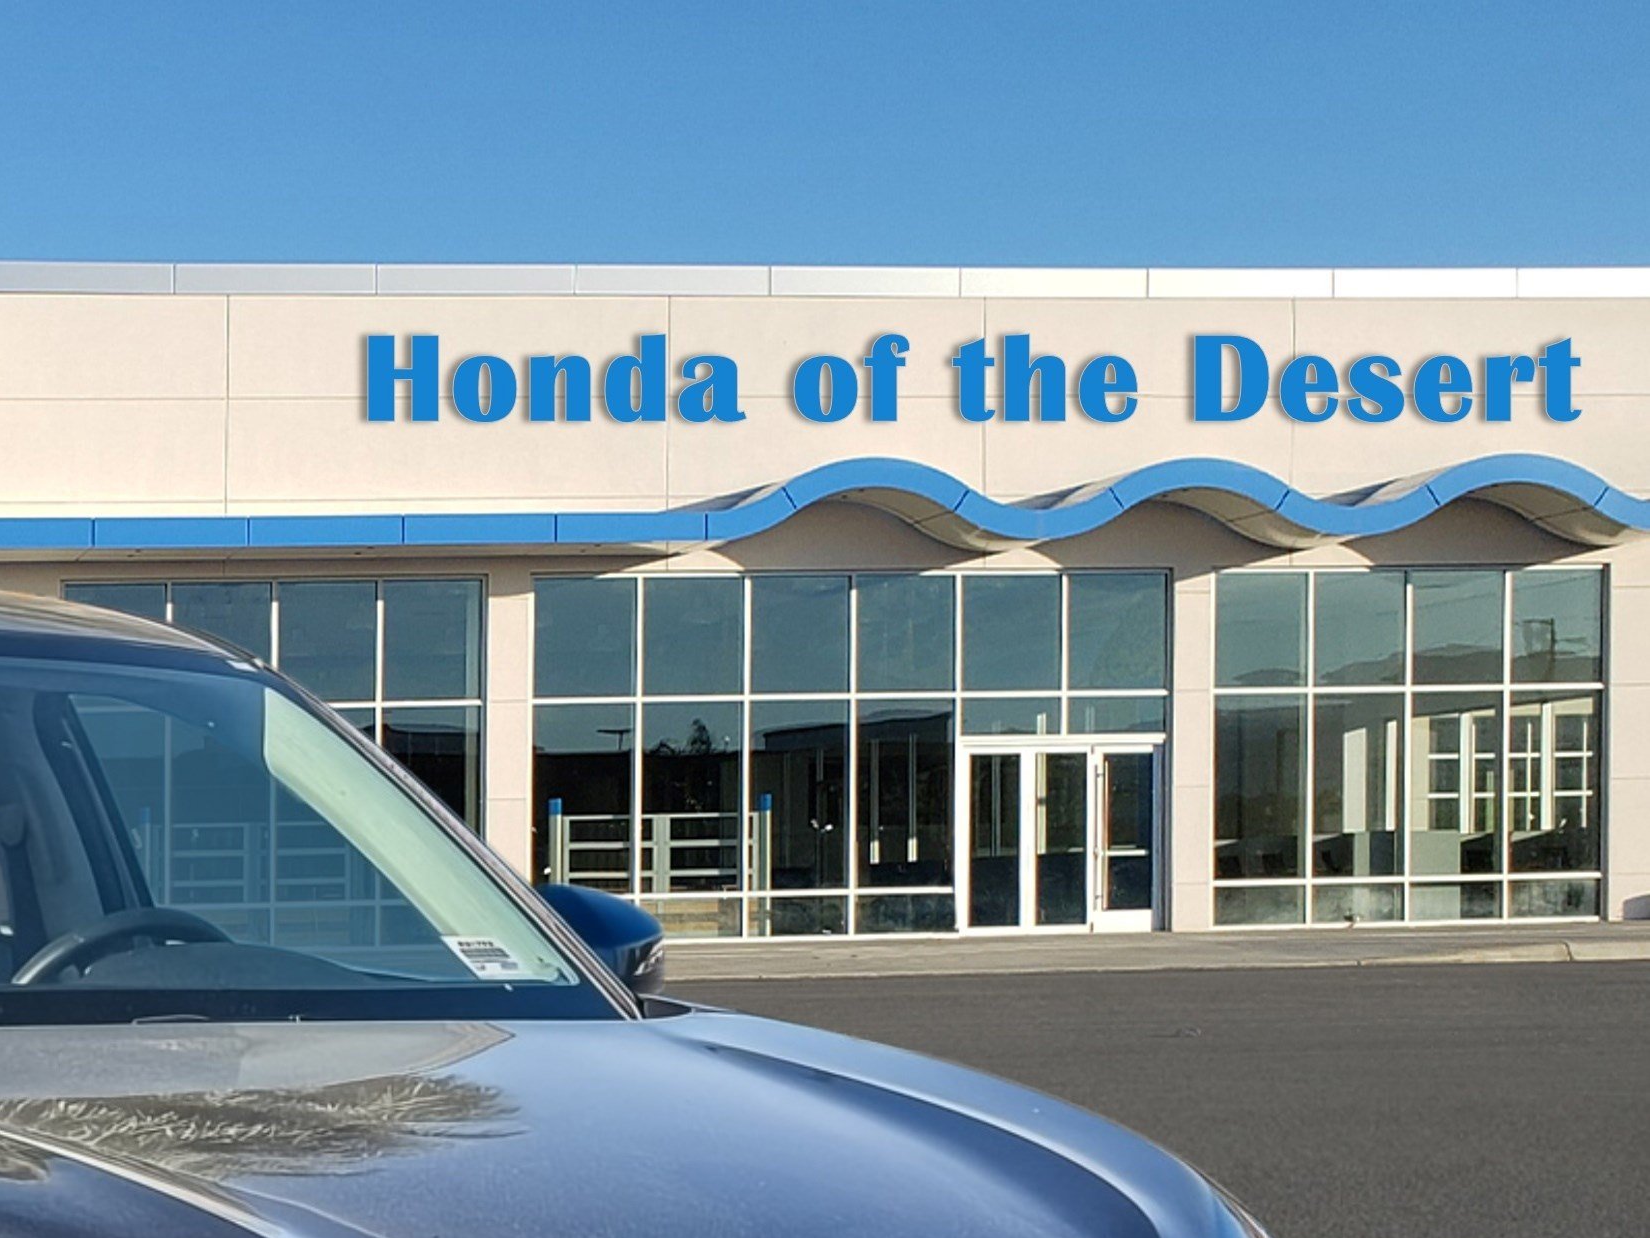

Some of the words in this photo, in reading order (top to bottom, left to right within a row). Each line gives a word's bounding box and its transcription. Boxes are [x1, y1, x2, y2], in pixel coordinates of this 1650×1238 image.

[366, 333, 748, 423] Honda
[793, 332, 911, 423] of
[951, 333, 1139, 423] the
[1193, 334, 1583, 423] Desert
